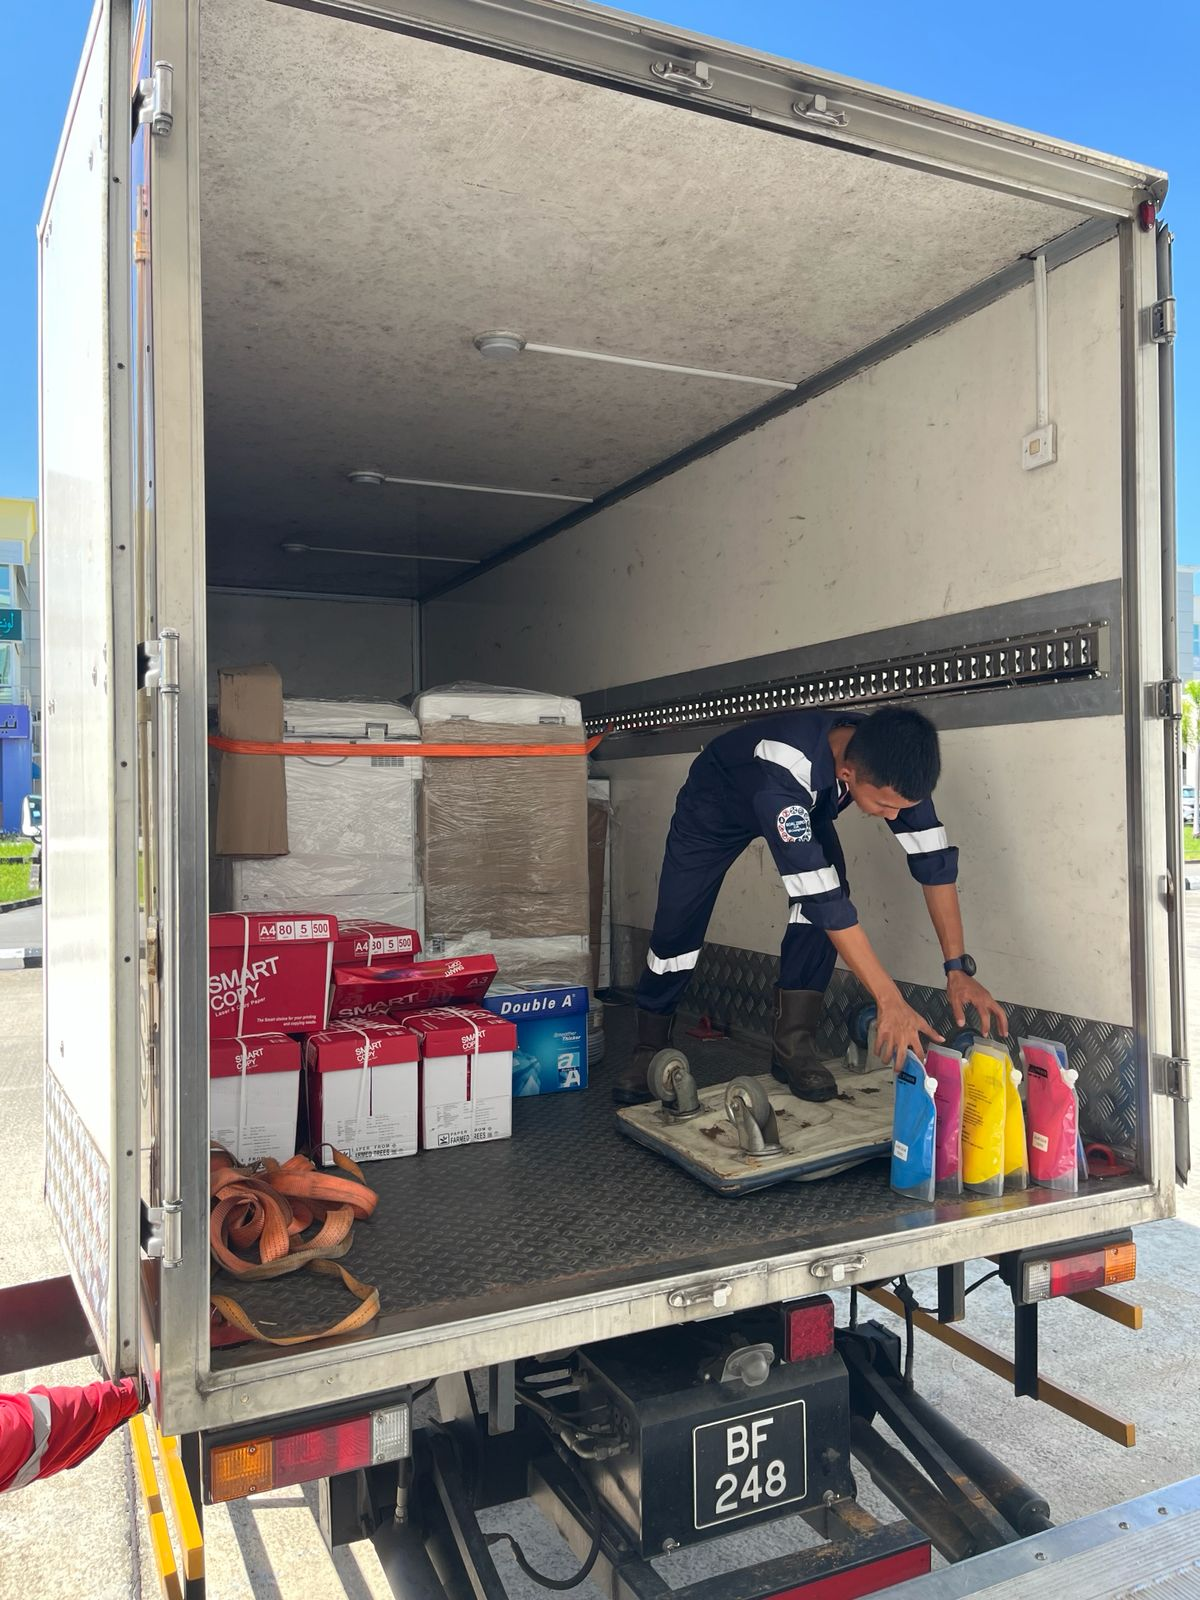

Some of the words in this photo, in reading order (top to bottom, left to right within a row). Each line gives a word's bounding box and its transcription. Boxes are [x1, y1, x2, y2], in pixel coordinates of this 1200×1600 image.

[260, 925, 276, 936] A4
[278, 924, 292, 935] 80
[301, 924, 307, 934] 5
[313, 923, 328, 934] 500
[355, 941, 369, 952] A4
[388, 939, 394, 949] 5
[398, 937, 411, 948] 500
[208, 955, 279, 994] SMART
[210, 982, 260, 1011] COPY
[338, 992, 419, 1016] SMART
[500, 997, 556, 1015] Double
[561, 994, 572, 1008] A
[235, 1047, 264, 1063] SART
[462, 1040, 478, 1050] COP
[236, 1058, 256, 1070] CPY
[726, 1417, 774, 1466] BF
[715, 1459, 787, 1515] 248
